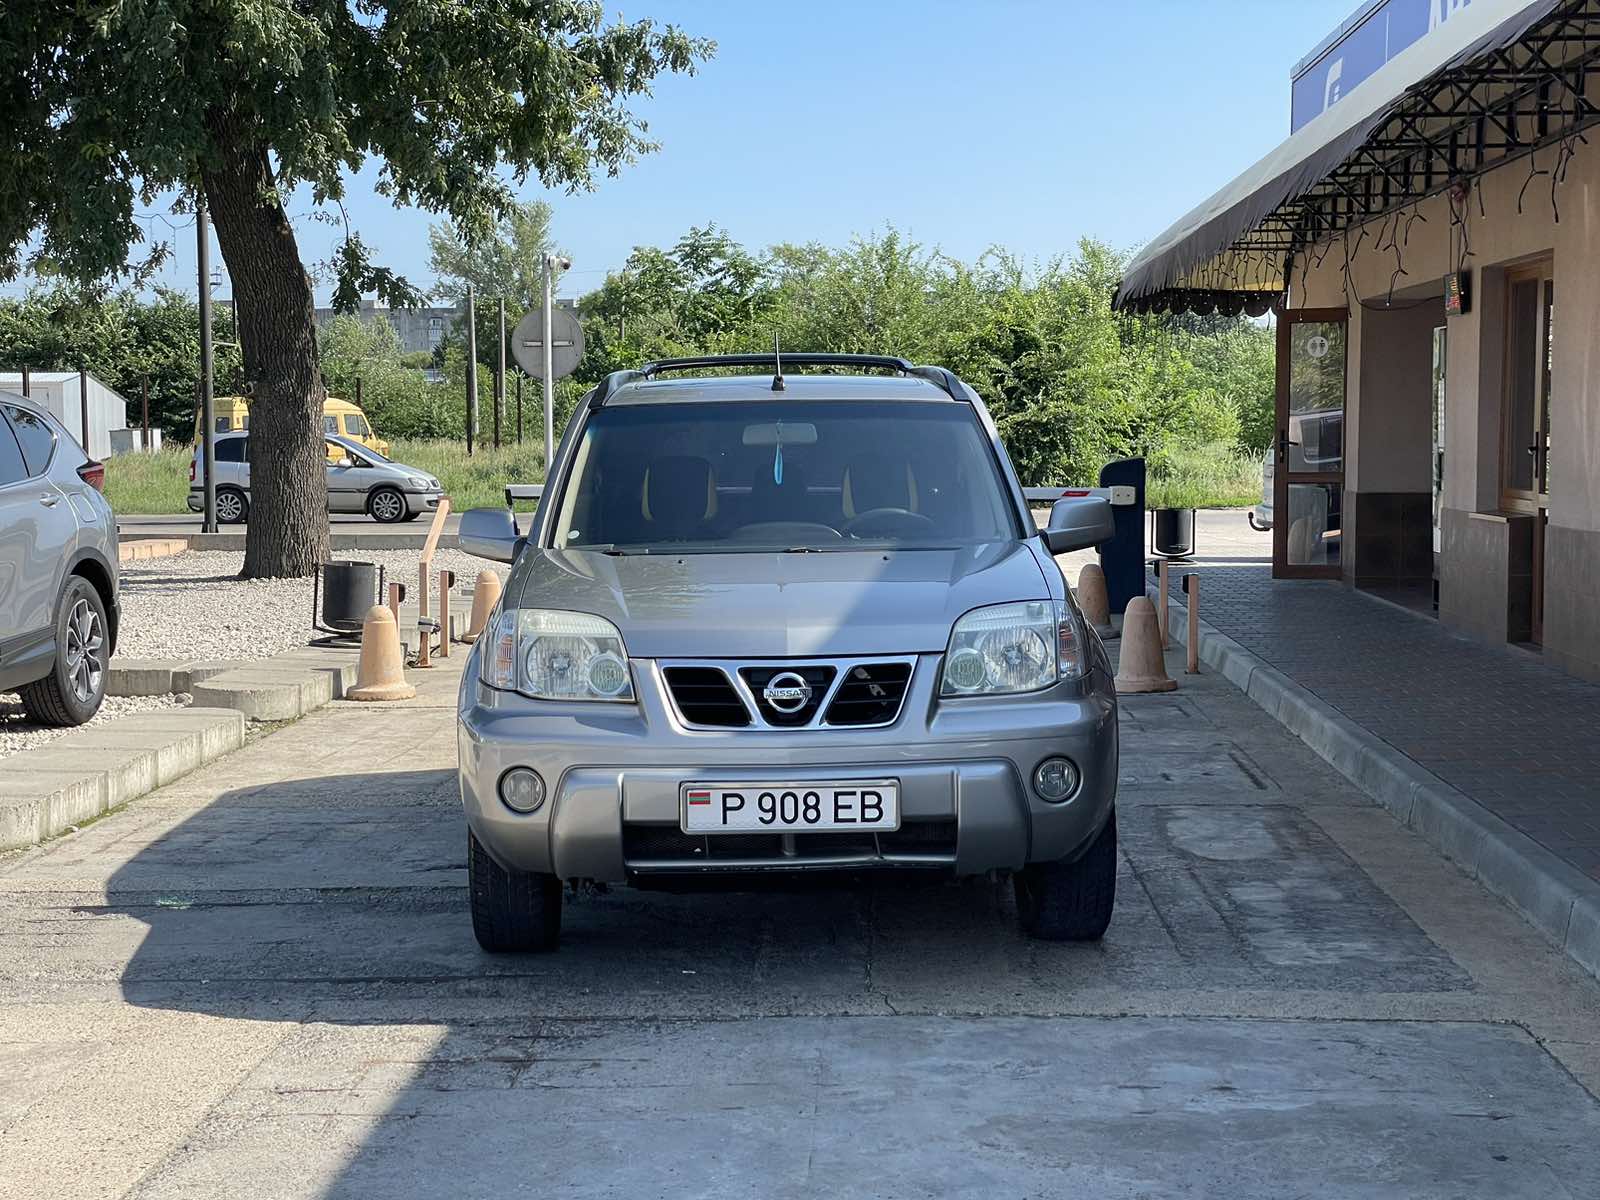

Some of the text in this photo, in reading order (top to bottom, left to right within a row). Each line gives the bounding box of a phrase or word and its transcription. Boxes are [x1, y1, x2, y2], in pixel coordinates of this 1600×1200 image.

[768, 689, 808, 698] NISSAN
[721, 790, 885, 825] P 908 EB
